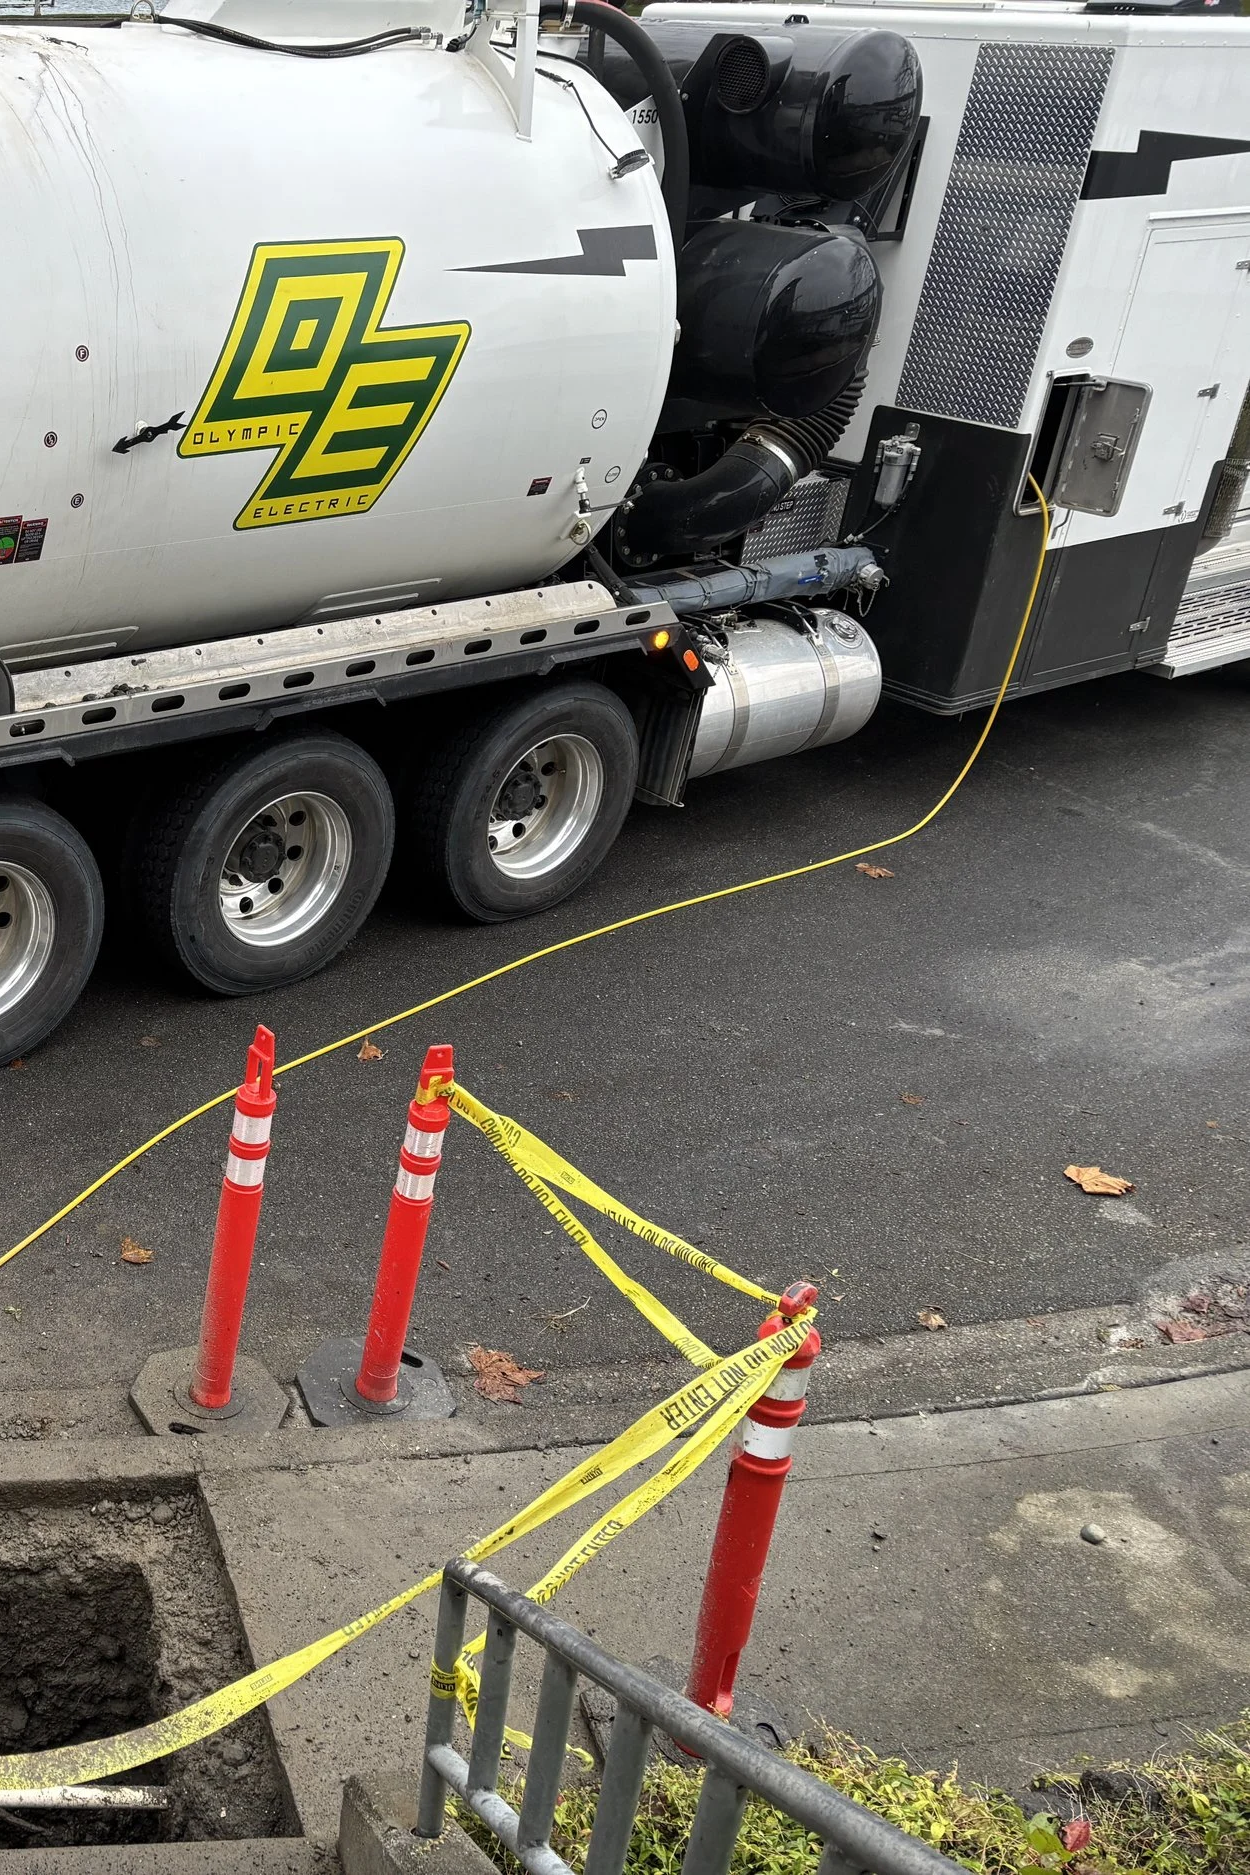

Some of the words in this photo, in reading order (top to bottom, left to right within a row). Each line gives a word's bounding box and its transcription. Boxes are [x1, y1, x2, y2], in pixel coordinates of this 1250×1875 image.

[632, 109, 659, 125] 1550
[192, 422, 300, 446] OLYMPIC
[252, 494, 369, 519] ELECTRIC
[780, 500, 794, 511] STEP
[743, 1346, 770, 1370] DO
[711, 1362, 748, 1396] NOT
[660, 1384, 717, 1431] ENTER
